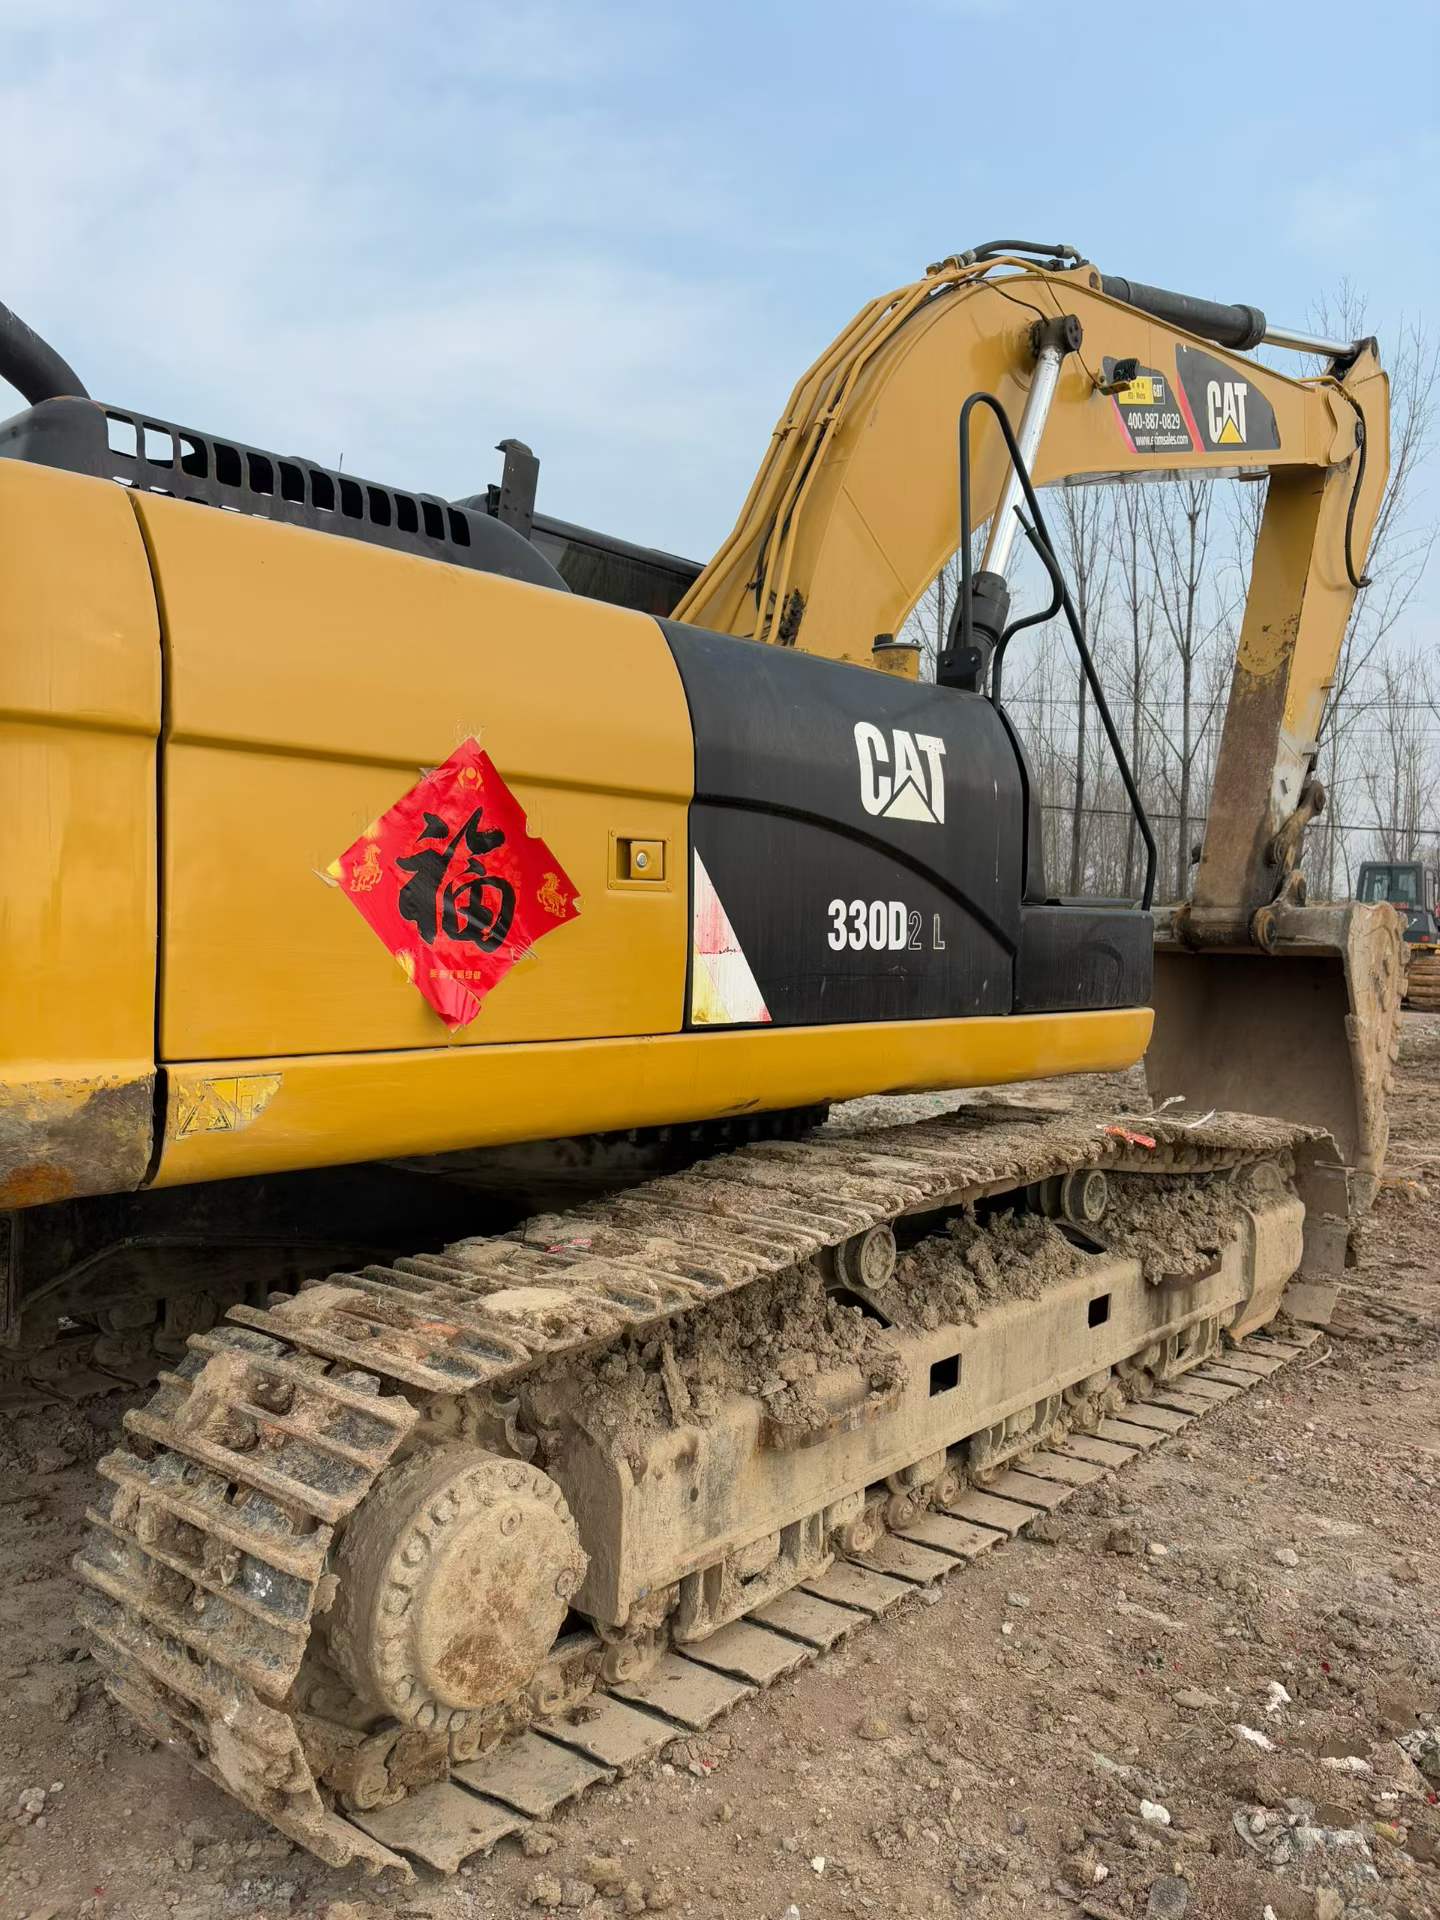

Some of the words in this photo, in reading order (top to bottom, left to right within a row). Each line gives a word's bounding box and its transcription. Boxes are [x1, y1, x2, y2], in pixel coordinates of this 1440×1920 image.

[1128, 412, 1180, 430] 400-887-0829
[1207, 380, 1248, 444] CAT
[854, 721, 947, 825] CAT
[395, 806, 516, 953] 福
[933, 913, 946, 950] L
